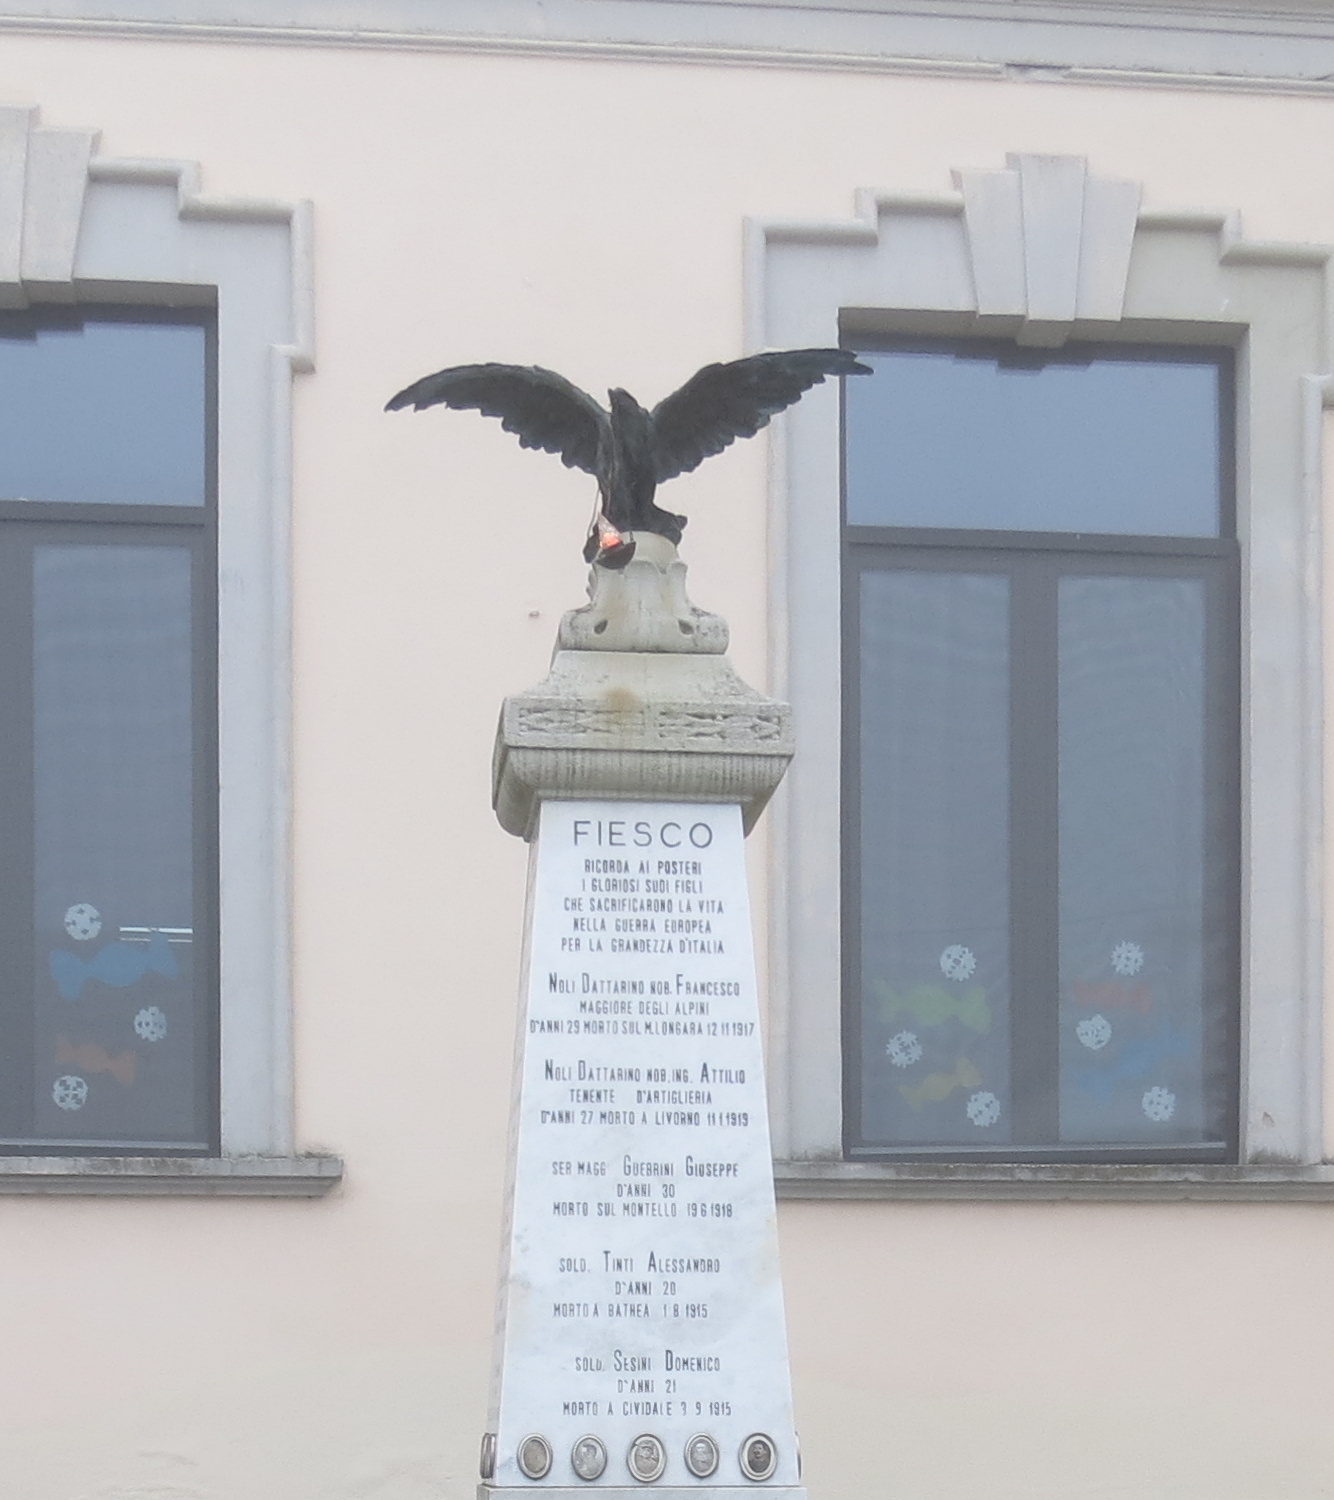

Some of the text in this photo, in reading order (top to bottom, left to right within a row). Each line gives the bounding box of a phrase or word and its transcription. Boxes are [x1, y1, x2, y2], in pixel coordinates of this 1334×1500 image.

[574, 821, 713, 848] FIESCO
[585, 859, 701, 875] RICORDA AI POSTERI
[582, 878, 703, 893] I GLORIOSI SUOI FIGLI
[564, 897, 724, 913] CHE SACRIFICARONO LA VITA
[573, 918, 712, 933] NELLA GUERRA EUROPEA
[562, 938, 580, 951] PER
[589, 939, 602, 952] LA
[611, 939, 673, 953] GRANDEZZA
[549, 973, 576, 993] NOLI
[582, 973, 644, 994] DATTARINO
[676, 974, 740, 996] FRANCESCO
[580, 1001, 709, 1015] MAGGIORE DEGLI ALPINI
[567, 1020, 580, 1034] 29
[584, 1021, 618, 1034] MORTO
[622, 1021, 641, 1035] SUL
[707, 1022, 717, 1036] 12
[732, 1022, 754, 1036] 1917
[545, 1060, 571, 1080] NOLI
[578, 1060, 641, 1082] DATTARINO
[700, 1062, 745, 1084] ATTILIO
[570, 1089, 615, 1103] TENENTE
[580, 1110, 593, 1124] 27
[600, 1111, 635, 1125] MORTO
[641, 1112, 647, 1124] A
[655, 1112, 699, 1126] LIVORNO
[552, 1161, 572, 1175] SER
[686, 1155, 738, 1177] GIUSEPPE
[662, 1184, 675, 1198] 30
[553, 1202, 588, 1216] MORTO
[597, 1202, 616, 1216] SUL
[623, 1203, 677, 1217] MONTELLO
[603, 1250, 634, 1271] TINTI
[647, 1251, 720, 1273] ALESSANDRO
[663, 1281, 676, 1295] 20
[553, 1303, 588, 1317] MORTO
[592, 1303, 599, 1316] A
[686, 1304, 708, 1318] 1915
[614, 1349, 652, 1371] SESINI
[665, 1350, 721, 1371] DOMENICO
[666, 1379, 676, 1393] 21
[563, 1402, 598, 1415] MORTO
[608, 1402, 614, 1415] A
[623, 1402, 672, 1416] CIVIDALE
[709, 1402, 732, 1416] 1915
